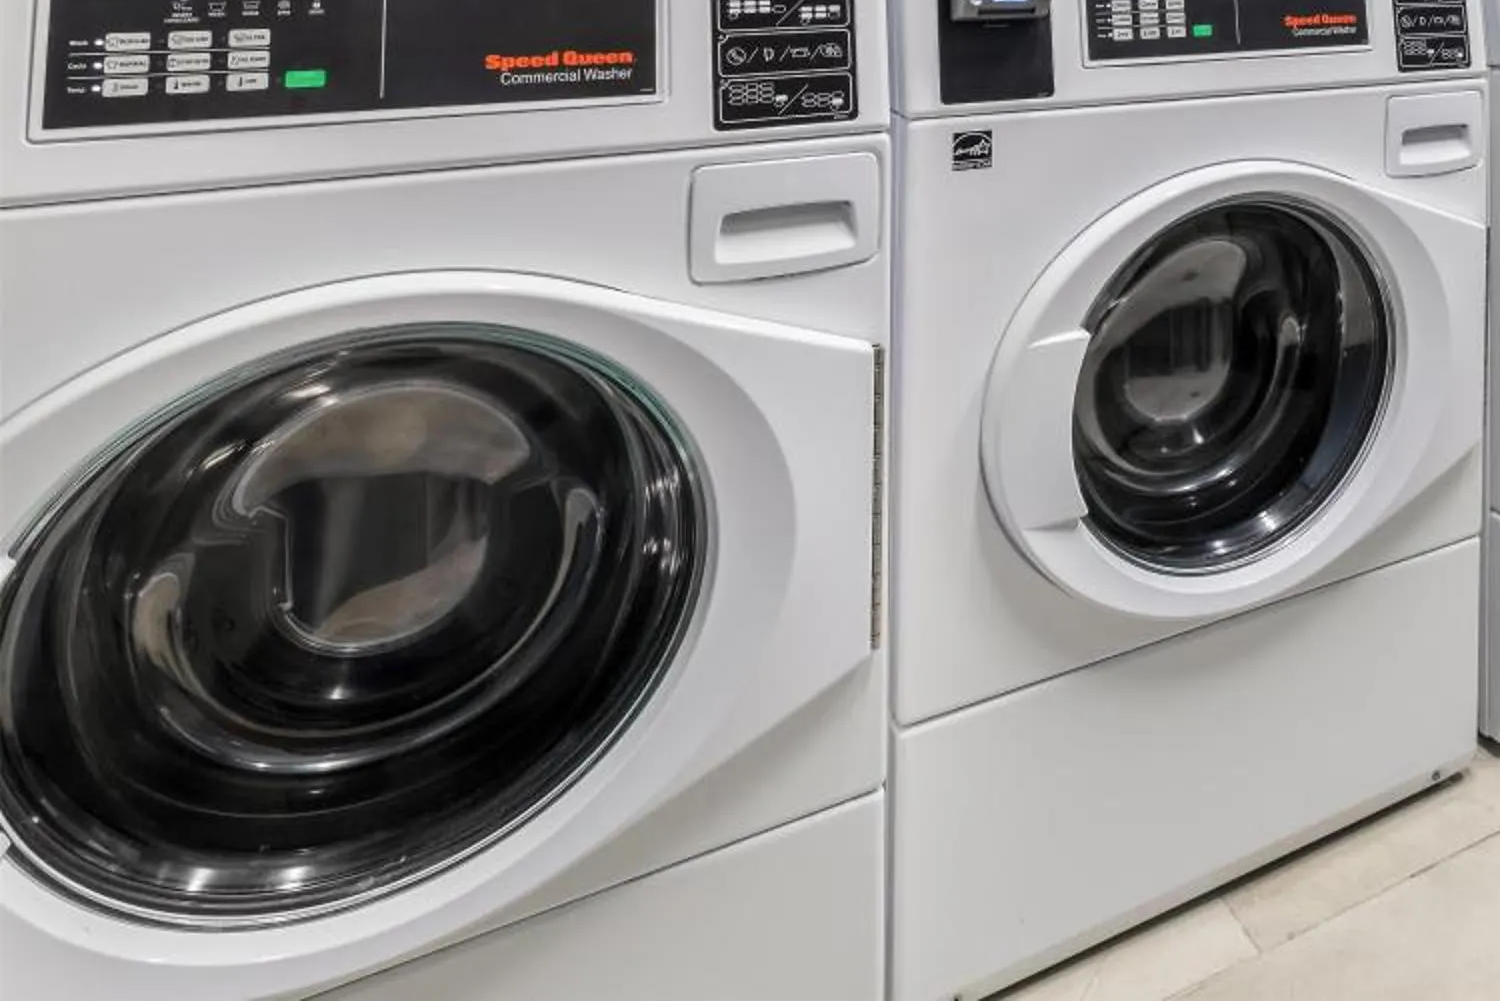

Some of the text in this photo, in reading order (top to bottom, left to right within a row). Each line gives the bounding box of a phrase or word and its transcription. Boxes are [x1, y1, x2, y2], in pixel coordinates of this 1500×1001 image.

[484, 50, 634, 71] Speed Queen
[500, 67, 632, 85] Commercial Washer
